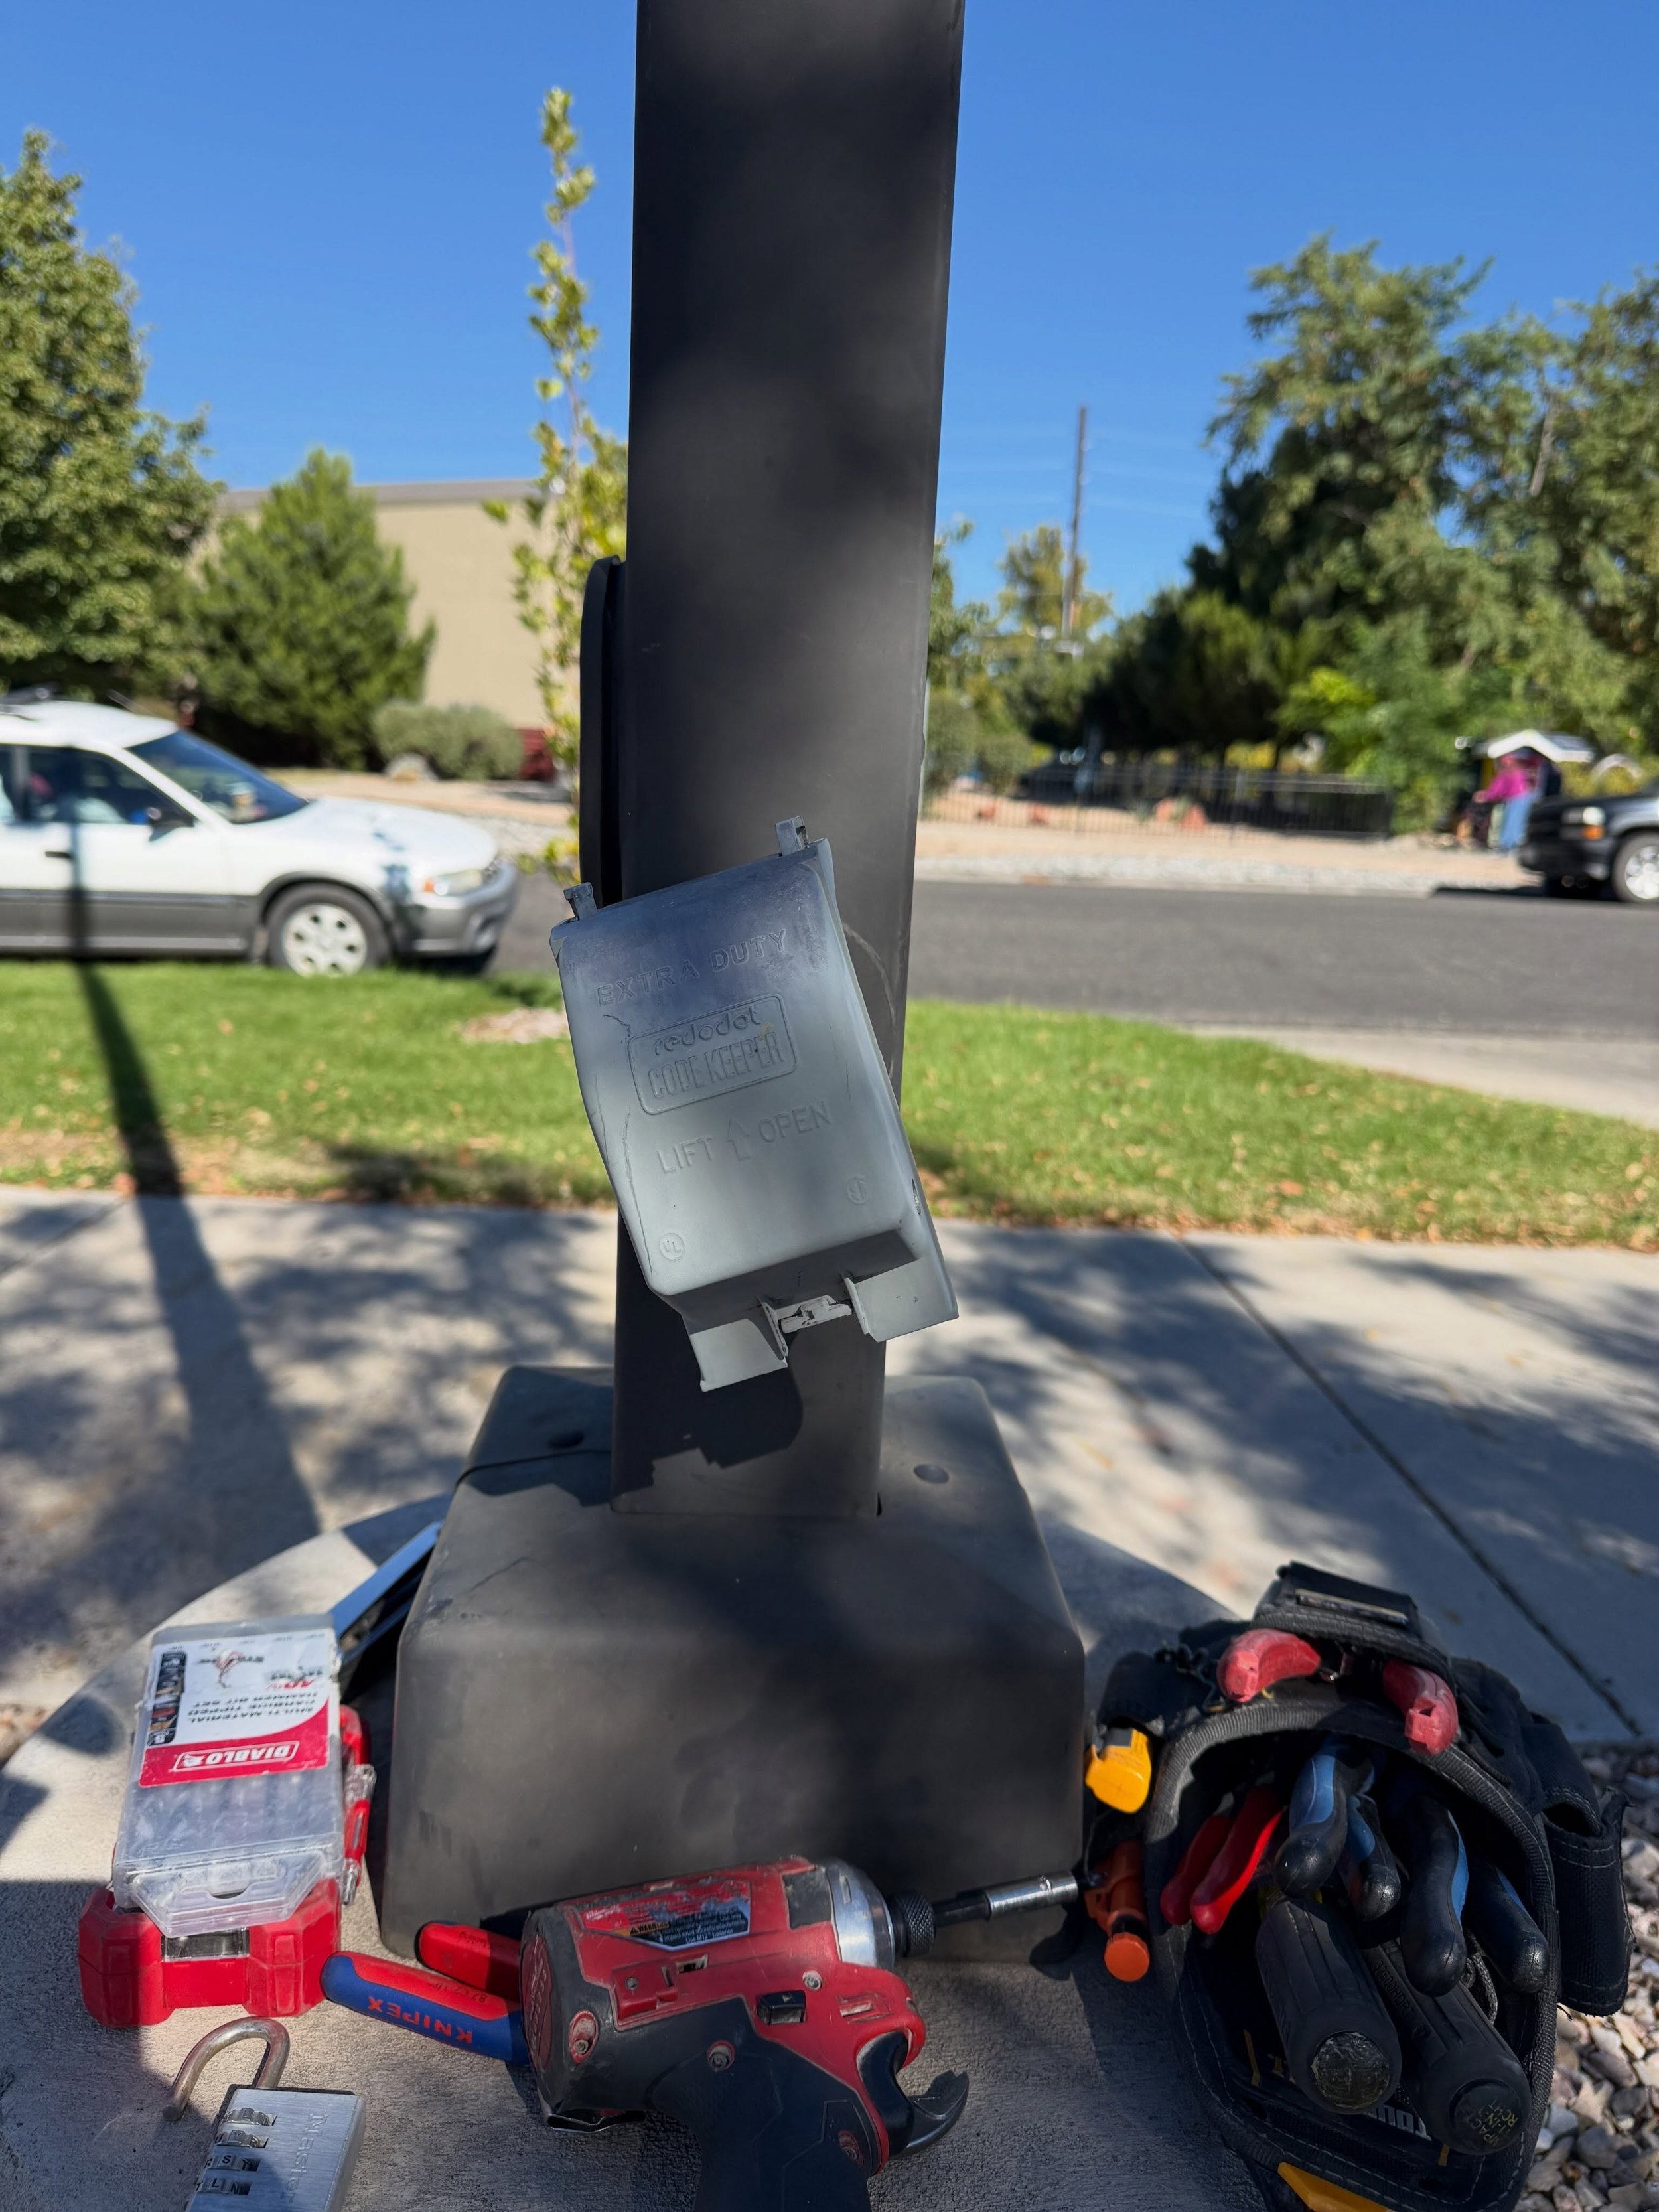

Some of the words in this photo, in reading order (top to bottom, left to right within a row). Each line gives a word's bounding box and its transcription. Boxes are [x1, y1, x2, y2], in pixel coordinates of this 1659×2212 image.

[597, 960, 699, 1007] EXTRA
[711, 928, 788, 972] DUTY
[647, 1049, 706, 1100] CODE
[707, 1031, 785, 1086] KEEPER
[656, 1136, 714, 1174] LIFT
[758, 1100, 831, 1143] OPEN
[205, 1744, 291, 1765] DIABLO
[368, 1996, 473, 2044] KNIPEX
[212, 2178, 220, 2188] L
[222, 2155, 232, 2164] S
[280, 2113, 329, 2204] Master
